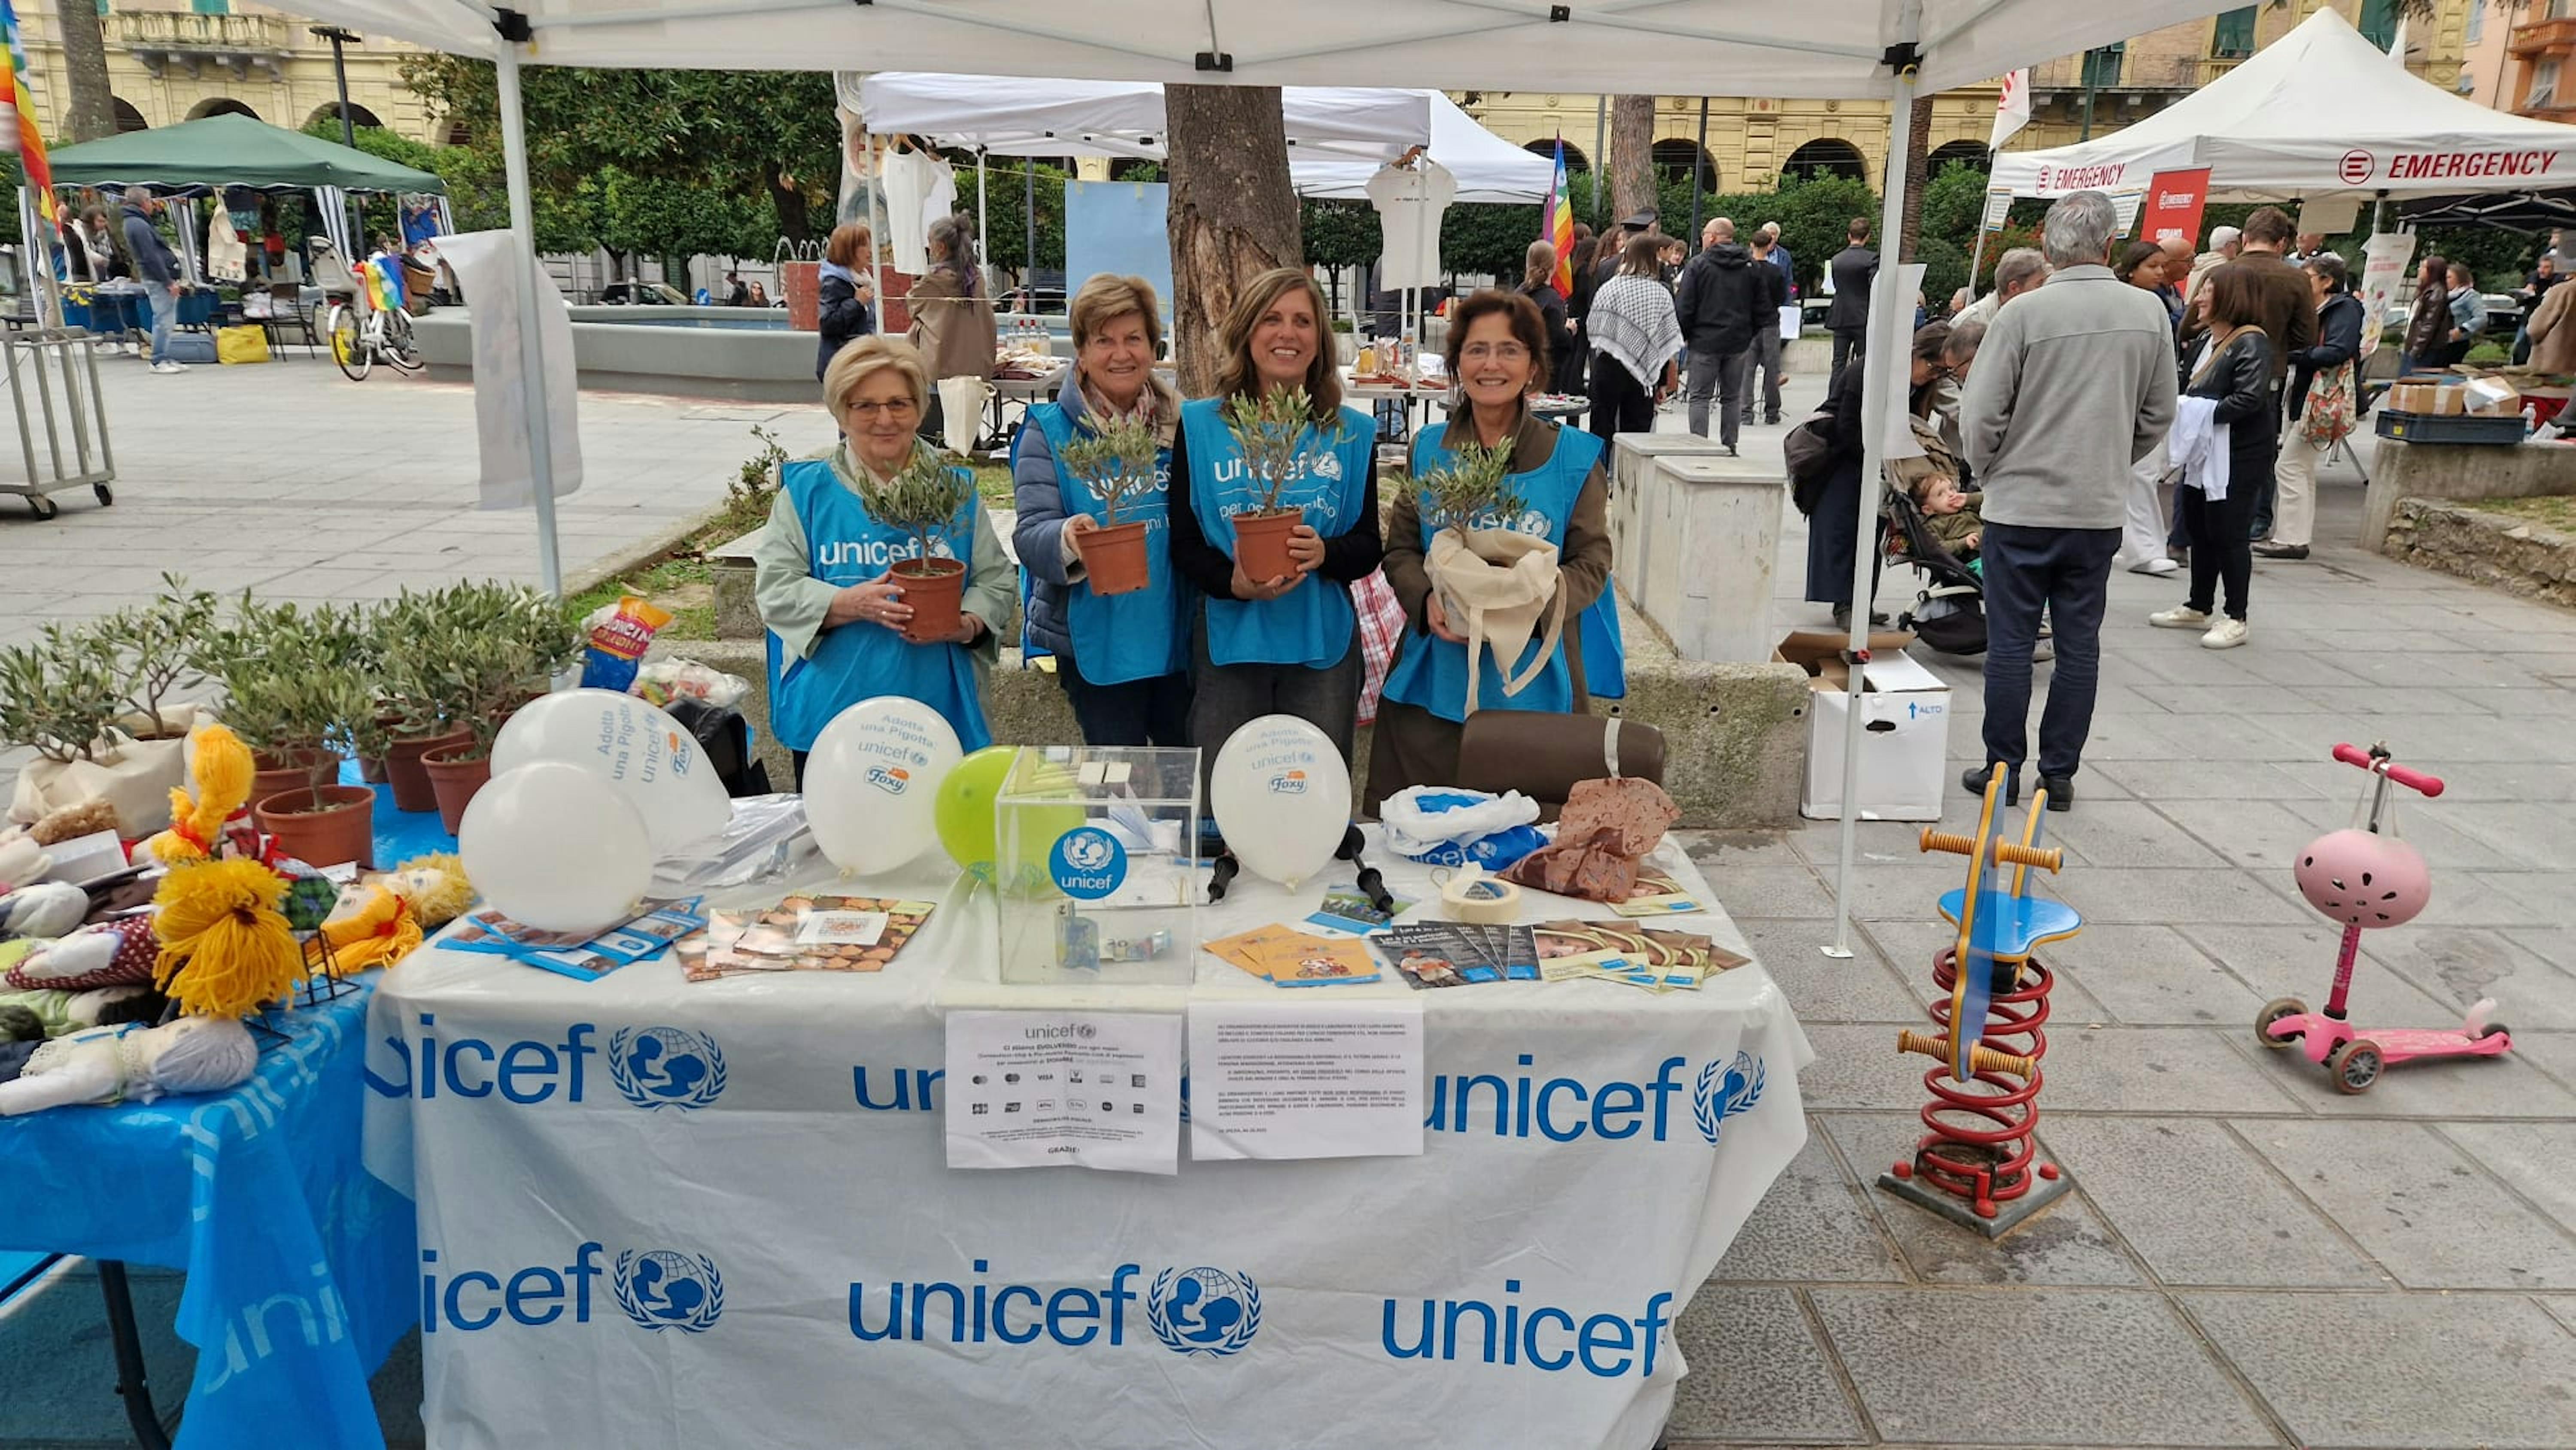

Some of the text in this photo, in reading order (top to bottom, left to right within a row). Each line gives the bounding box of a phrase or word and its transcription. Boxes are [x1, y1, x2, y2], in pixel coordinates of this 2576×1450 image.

[2054, 163, 2126, 190] EMERGENCY
[2388, 150, 2558, 179] EMERGENCY
[820, 534, 920, 566] unicef
[1919, 706, 1942, 714] ALTO
[598, 710, 614, 755] Adotta
[860, 723, 885, 732] una
[882, 714, 924, 732] Adotta
[641, 727, 661, 783] unicef
[858, 740, 911, 761] unicef
[1251, 752, 1296, 770] unicef
[612, 750, 629, 780] una
[868, 768, 904, 792] Foxy
[1271, 777, 1304, 791] Foxy
[1062, 874, 1113, 890] unicef
[1026, 1023, 1076, 1039] unicef
[849, 1259, 1140, 1346] unicef
[1382, 1280, 1673, 1377] unicef
